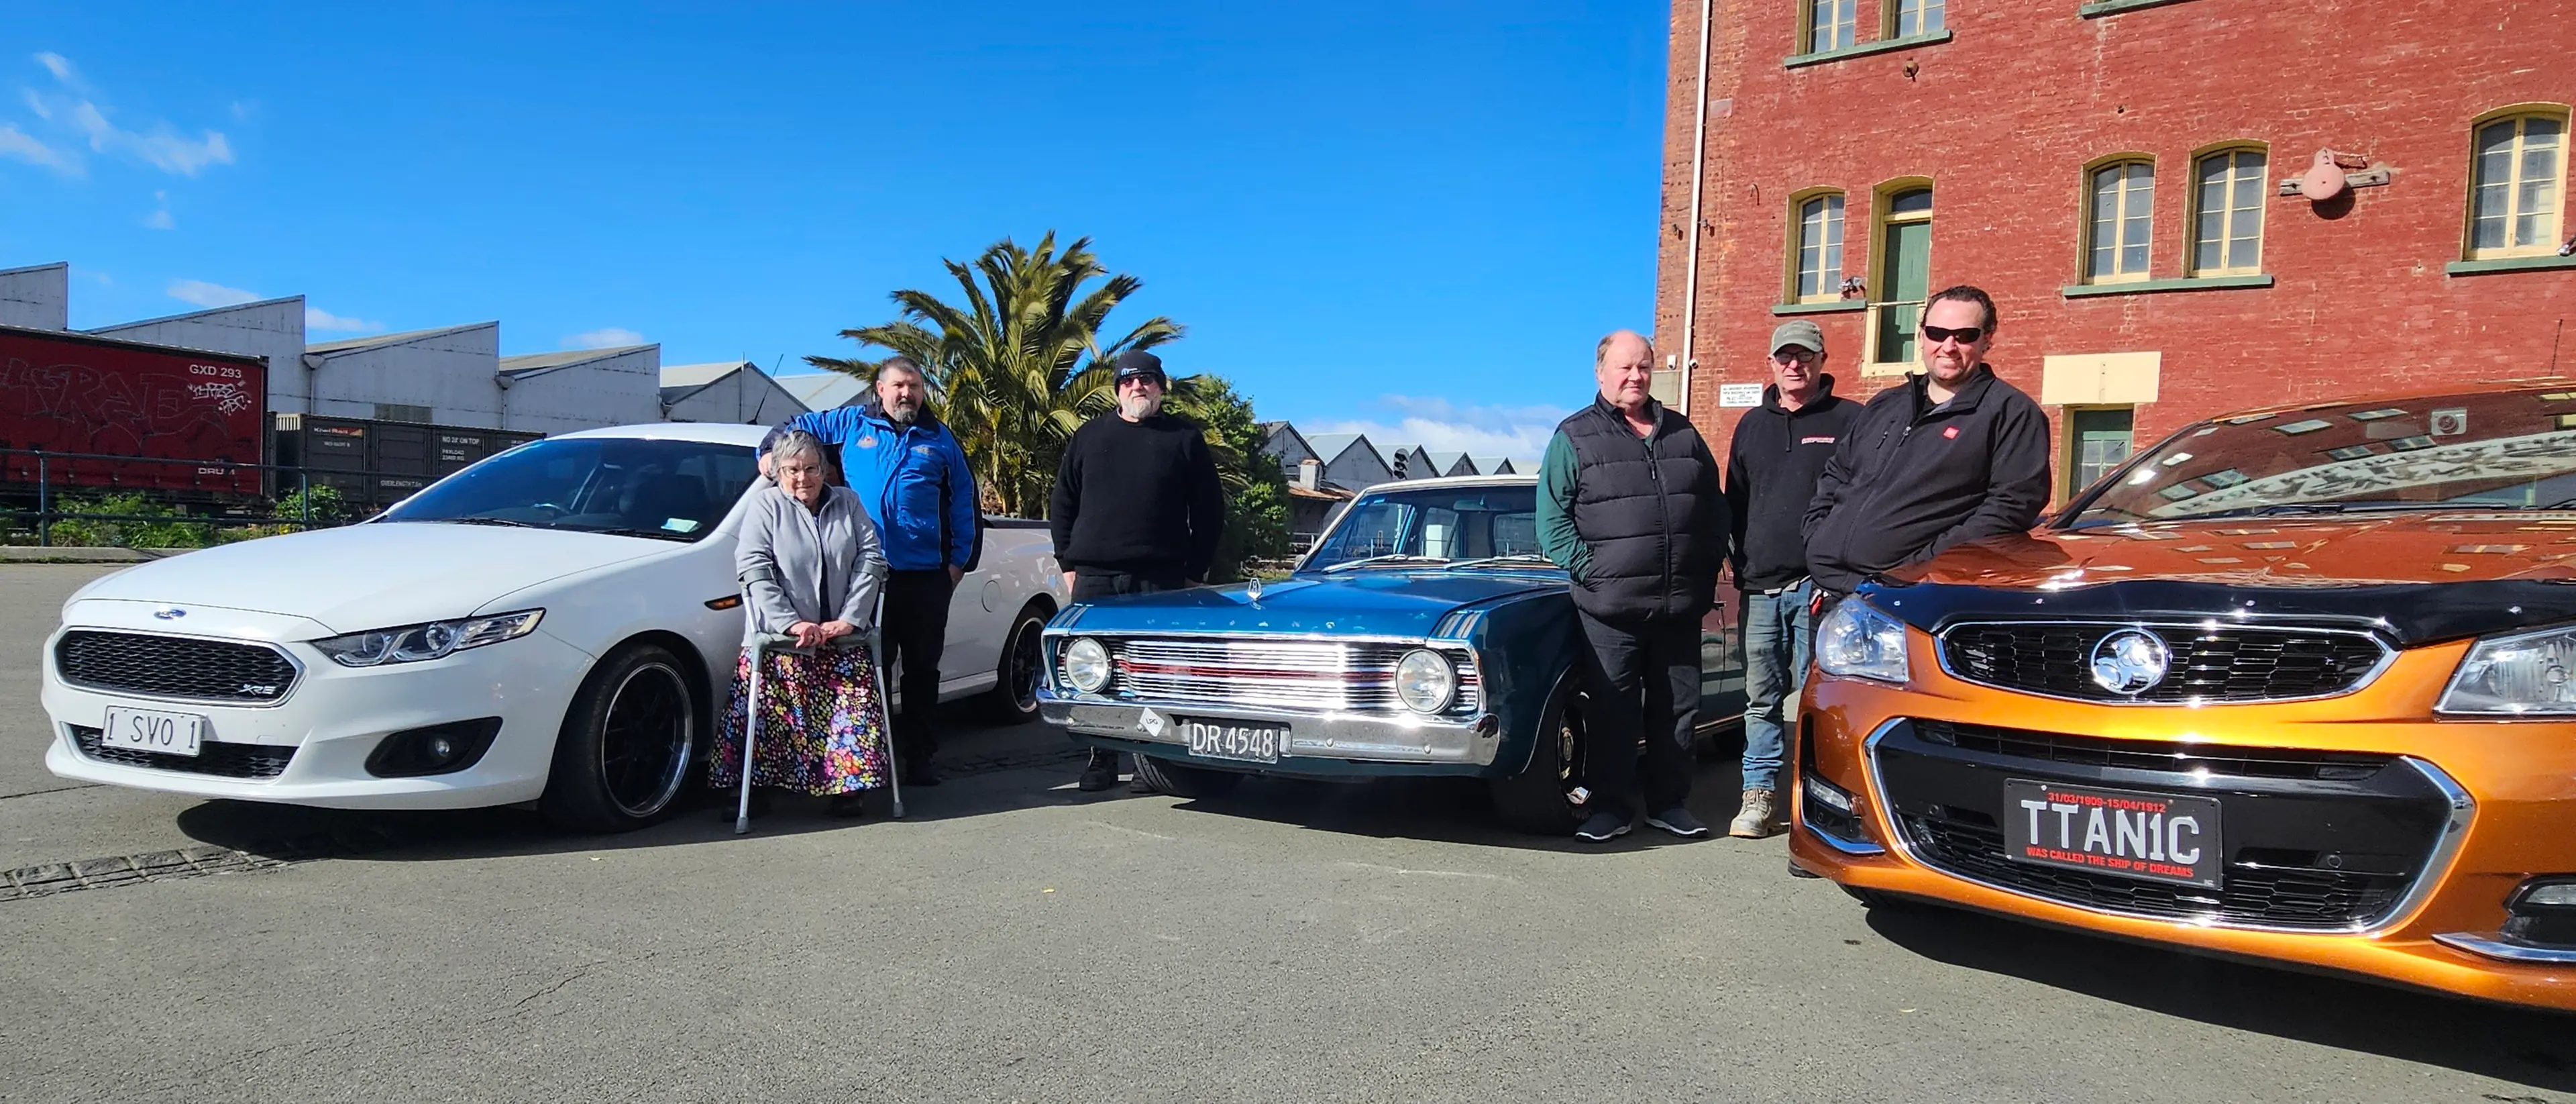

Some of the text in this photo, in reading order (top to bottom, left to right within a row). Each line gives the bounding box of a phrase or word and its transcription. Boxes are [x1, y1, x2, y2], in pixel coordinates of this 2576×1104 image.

[189, 364, 241, 378] GXD 293
[2026, 846, 2194, 879] WAS CALLED THE SHIP OF DREAMS
